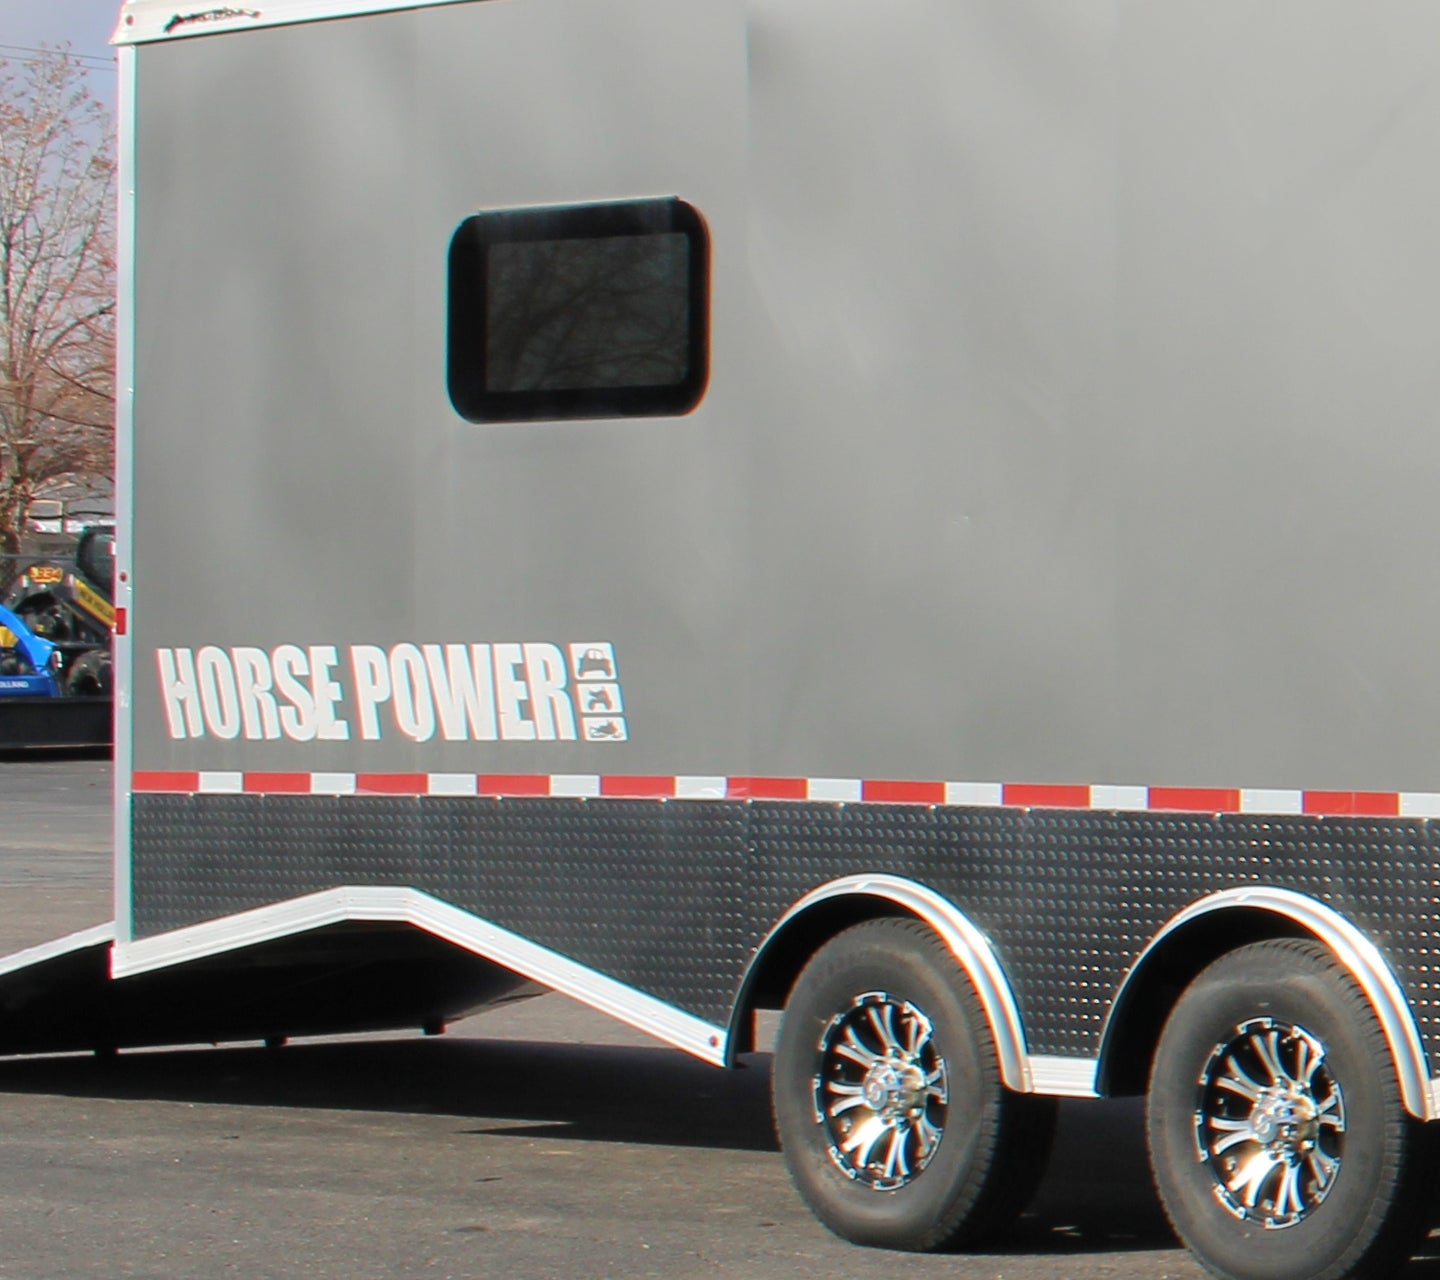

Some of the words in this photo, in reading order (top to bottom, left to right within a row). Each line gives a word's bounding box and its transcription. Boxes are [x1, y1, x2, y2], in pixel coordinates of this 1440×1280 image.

[0, 680, 29, 689] OLLAND
[156, 643, 350, 742] HORSE
[349, 642, 578, 742] POWER
